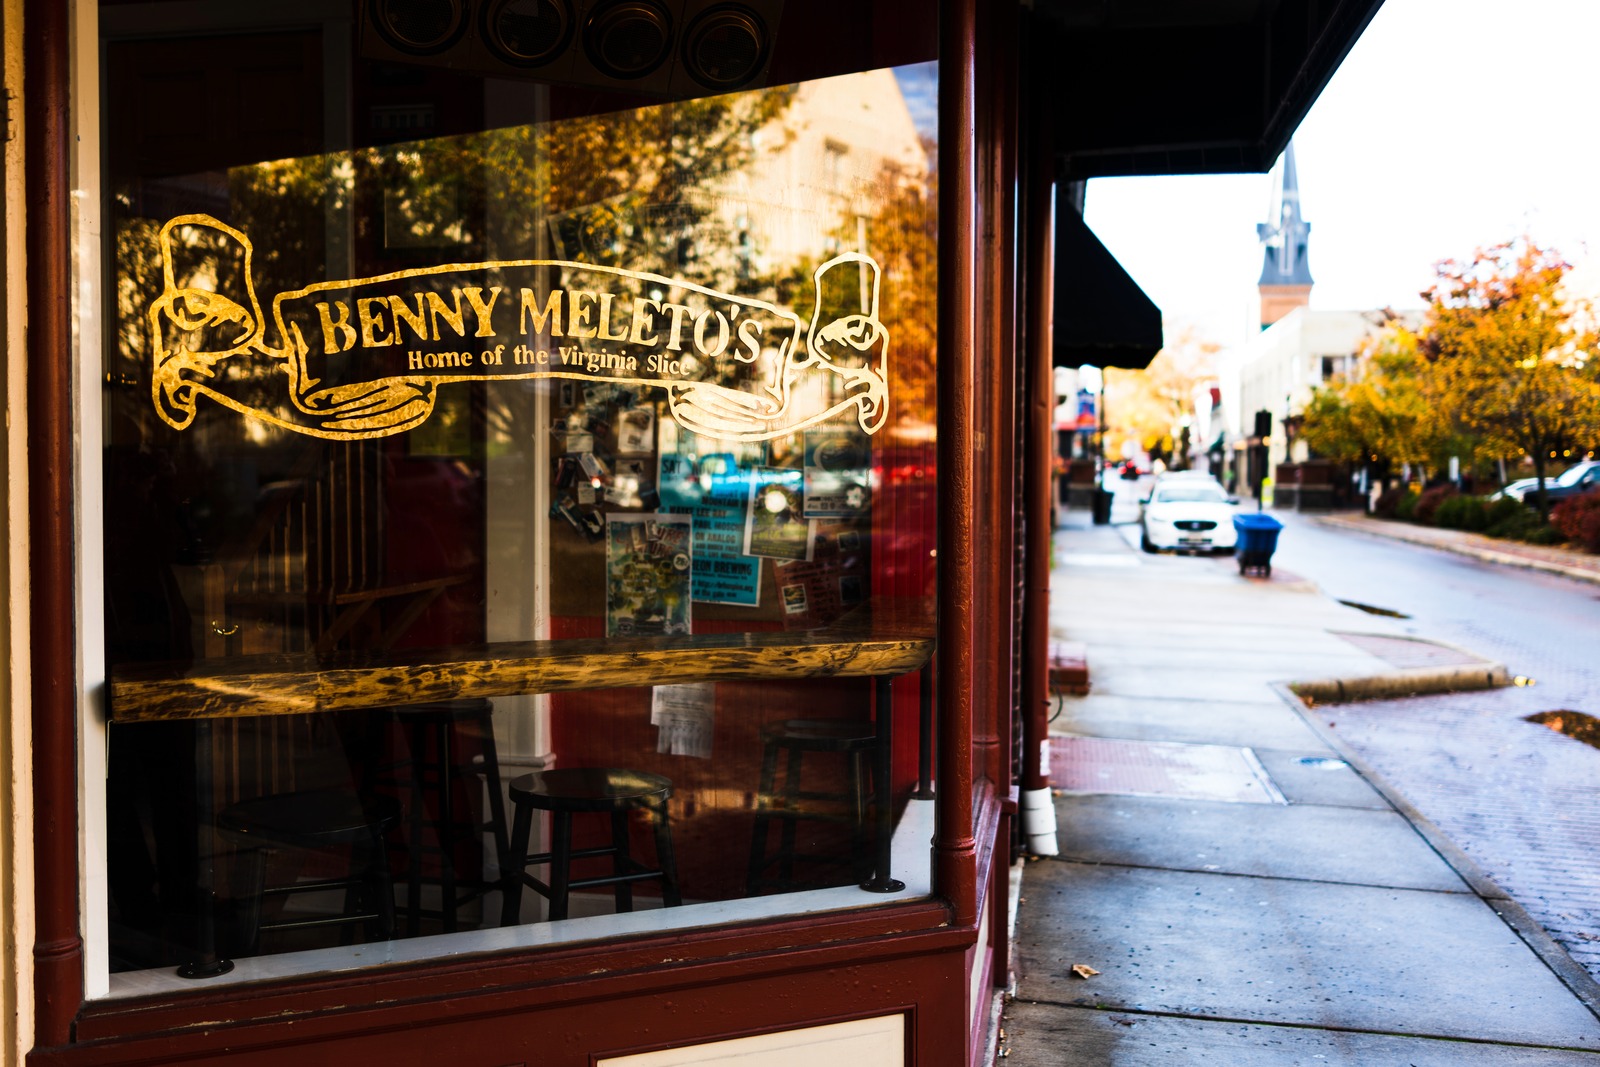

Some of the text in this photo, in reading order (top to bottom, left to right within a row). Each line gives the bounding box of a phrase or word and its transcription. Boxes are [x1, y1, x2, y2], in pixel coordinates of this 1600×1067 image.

[314, 286, 763, 364] BENNY MELETO'S
[407, 344, 691, 376] Home of the Virginia Slice
[714, 561, 753, 576] BREWING
